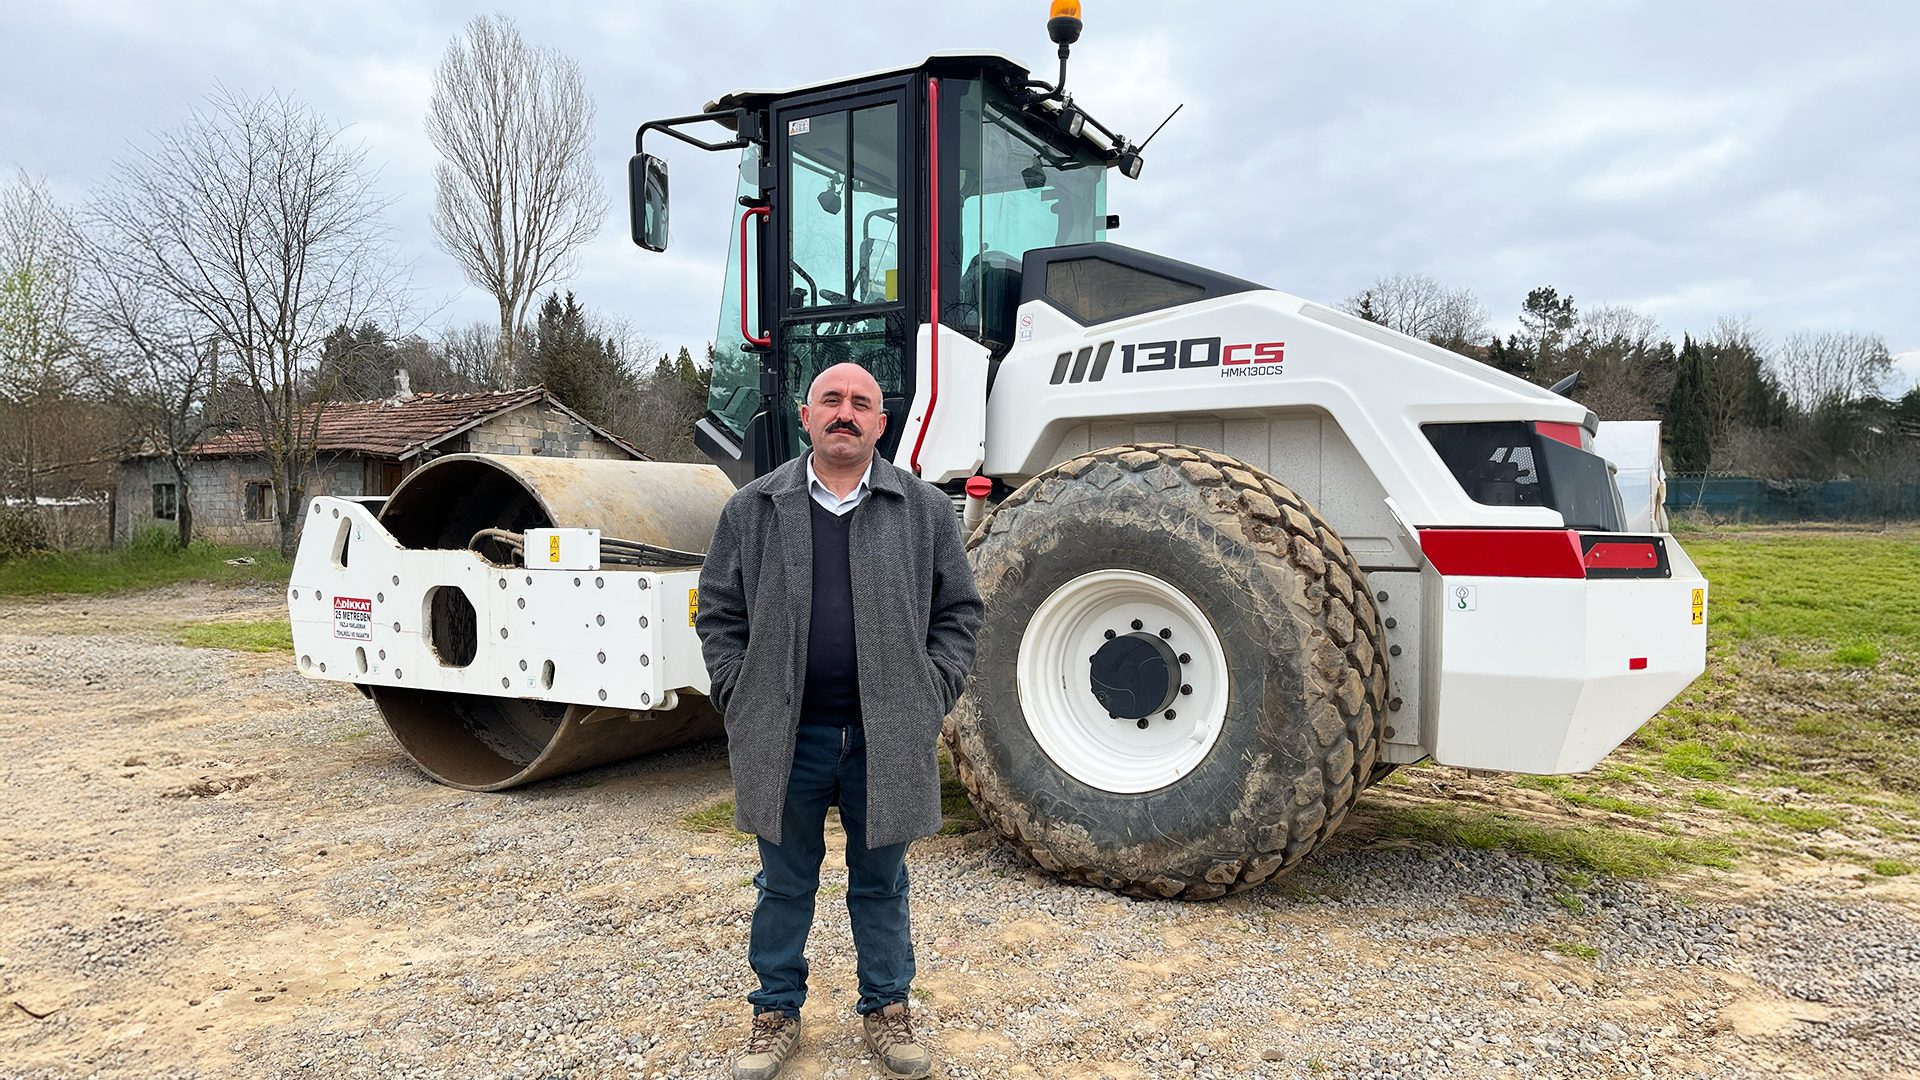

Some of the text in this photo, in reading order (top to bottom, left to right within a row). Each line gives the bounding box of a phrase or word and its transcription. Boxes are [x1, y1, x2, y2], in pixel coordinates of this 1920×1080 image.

[1221, 365, 1283, 378] HMK130CS
[342, 599, 370, 610] DİKKAT
[335, 610, 371, 622] 25 METREDEN
